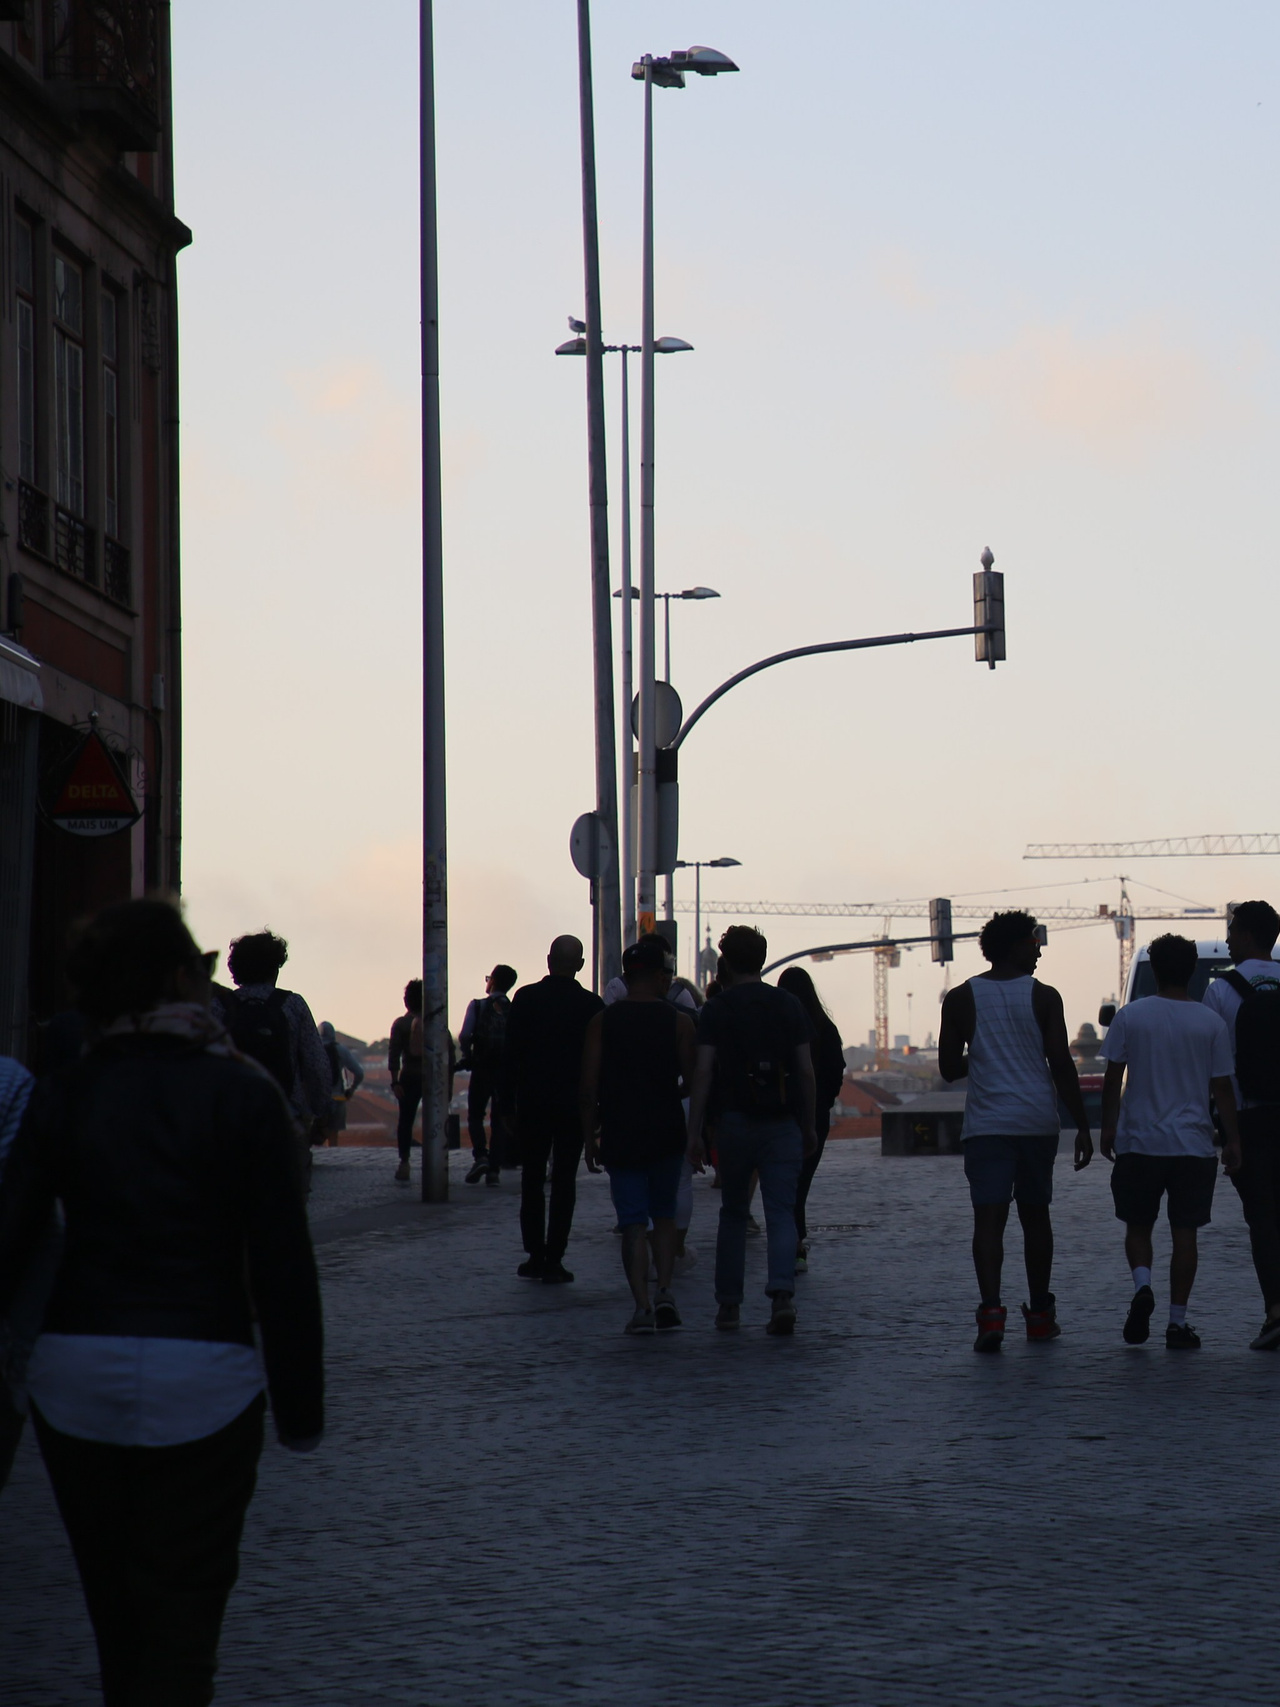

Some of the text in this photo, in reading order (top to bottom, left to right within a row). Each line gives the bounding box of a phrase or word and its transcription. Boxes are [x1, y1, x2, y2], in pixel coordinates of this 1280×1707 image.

[67, 784, 119, 799] DELTA
[68, 820, 118, 830] MAIS UM
